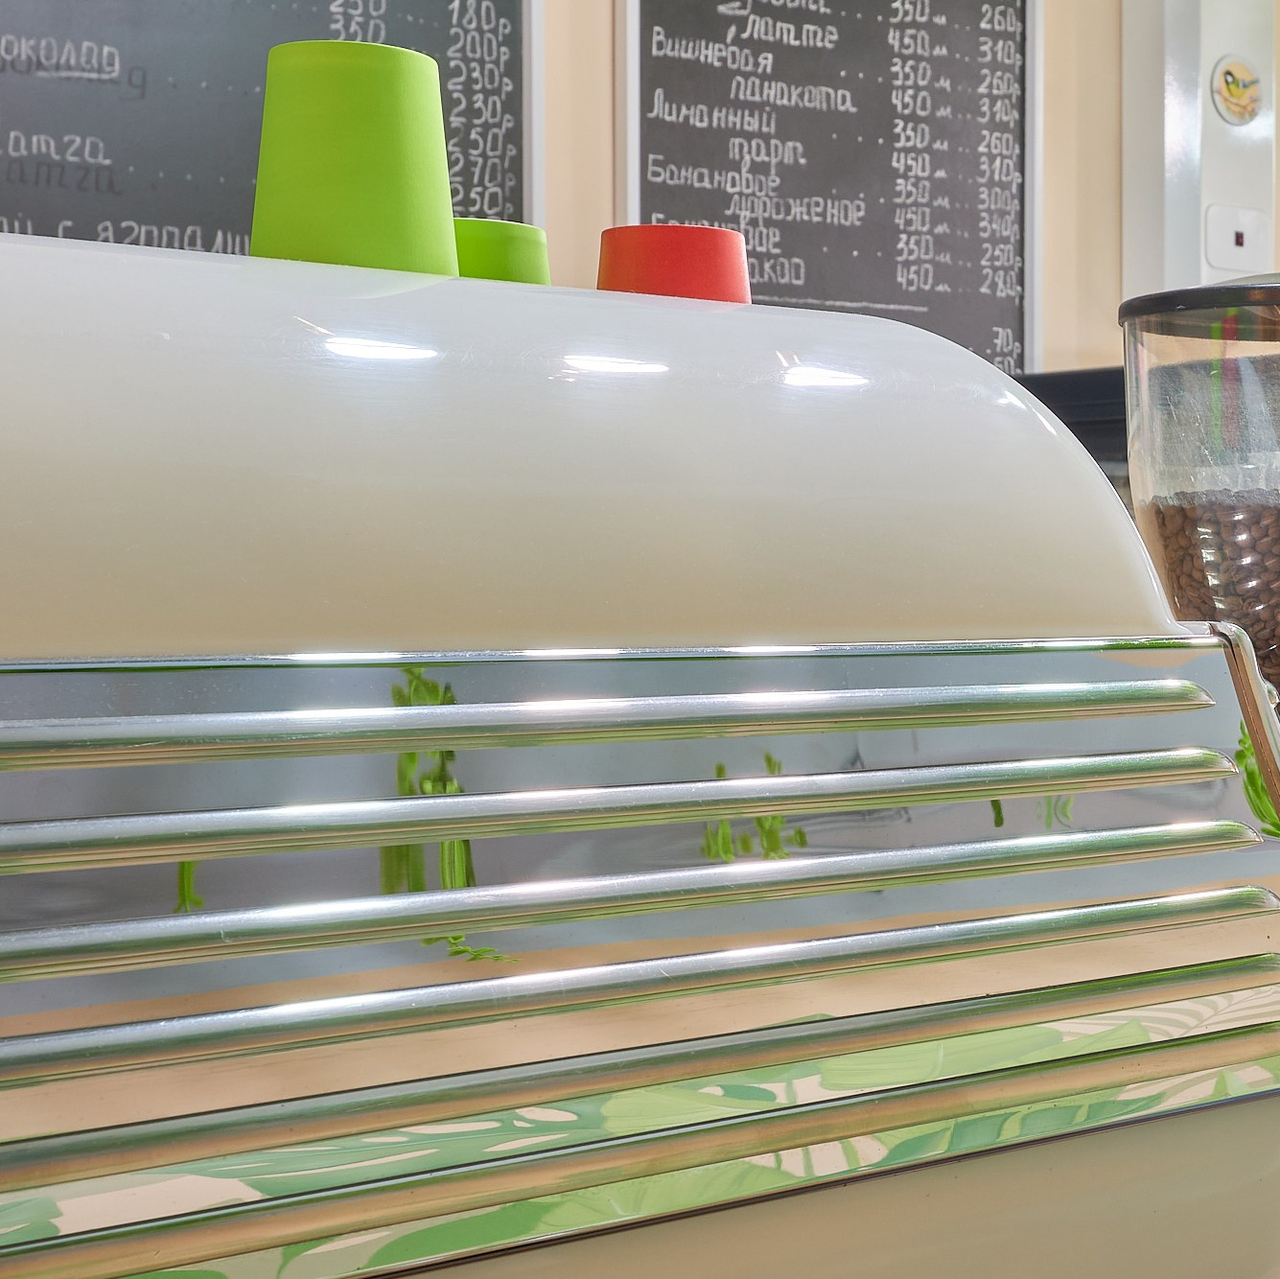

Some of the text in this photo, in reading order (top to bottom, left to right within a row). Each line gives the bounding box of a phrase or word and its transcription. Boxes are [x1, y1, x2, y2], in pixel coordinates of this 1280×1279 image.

[740, 13, 839, 49] латте
[647, 88, 776, 135] Лимонный
[648, 154, 781, 197] Банановое
[729, 137, 807, 176] тарт
[724, 194, 866, 228] мороженое
